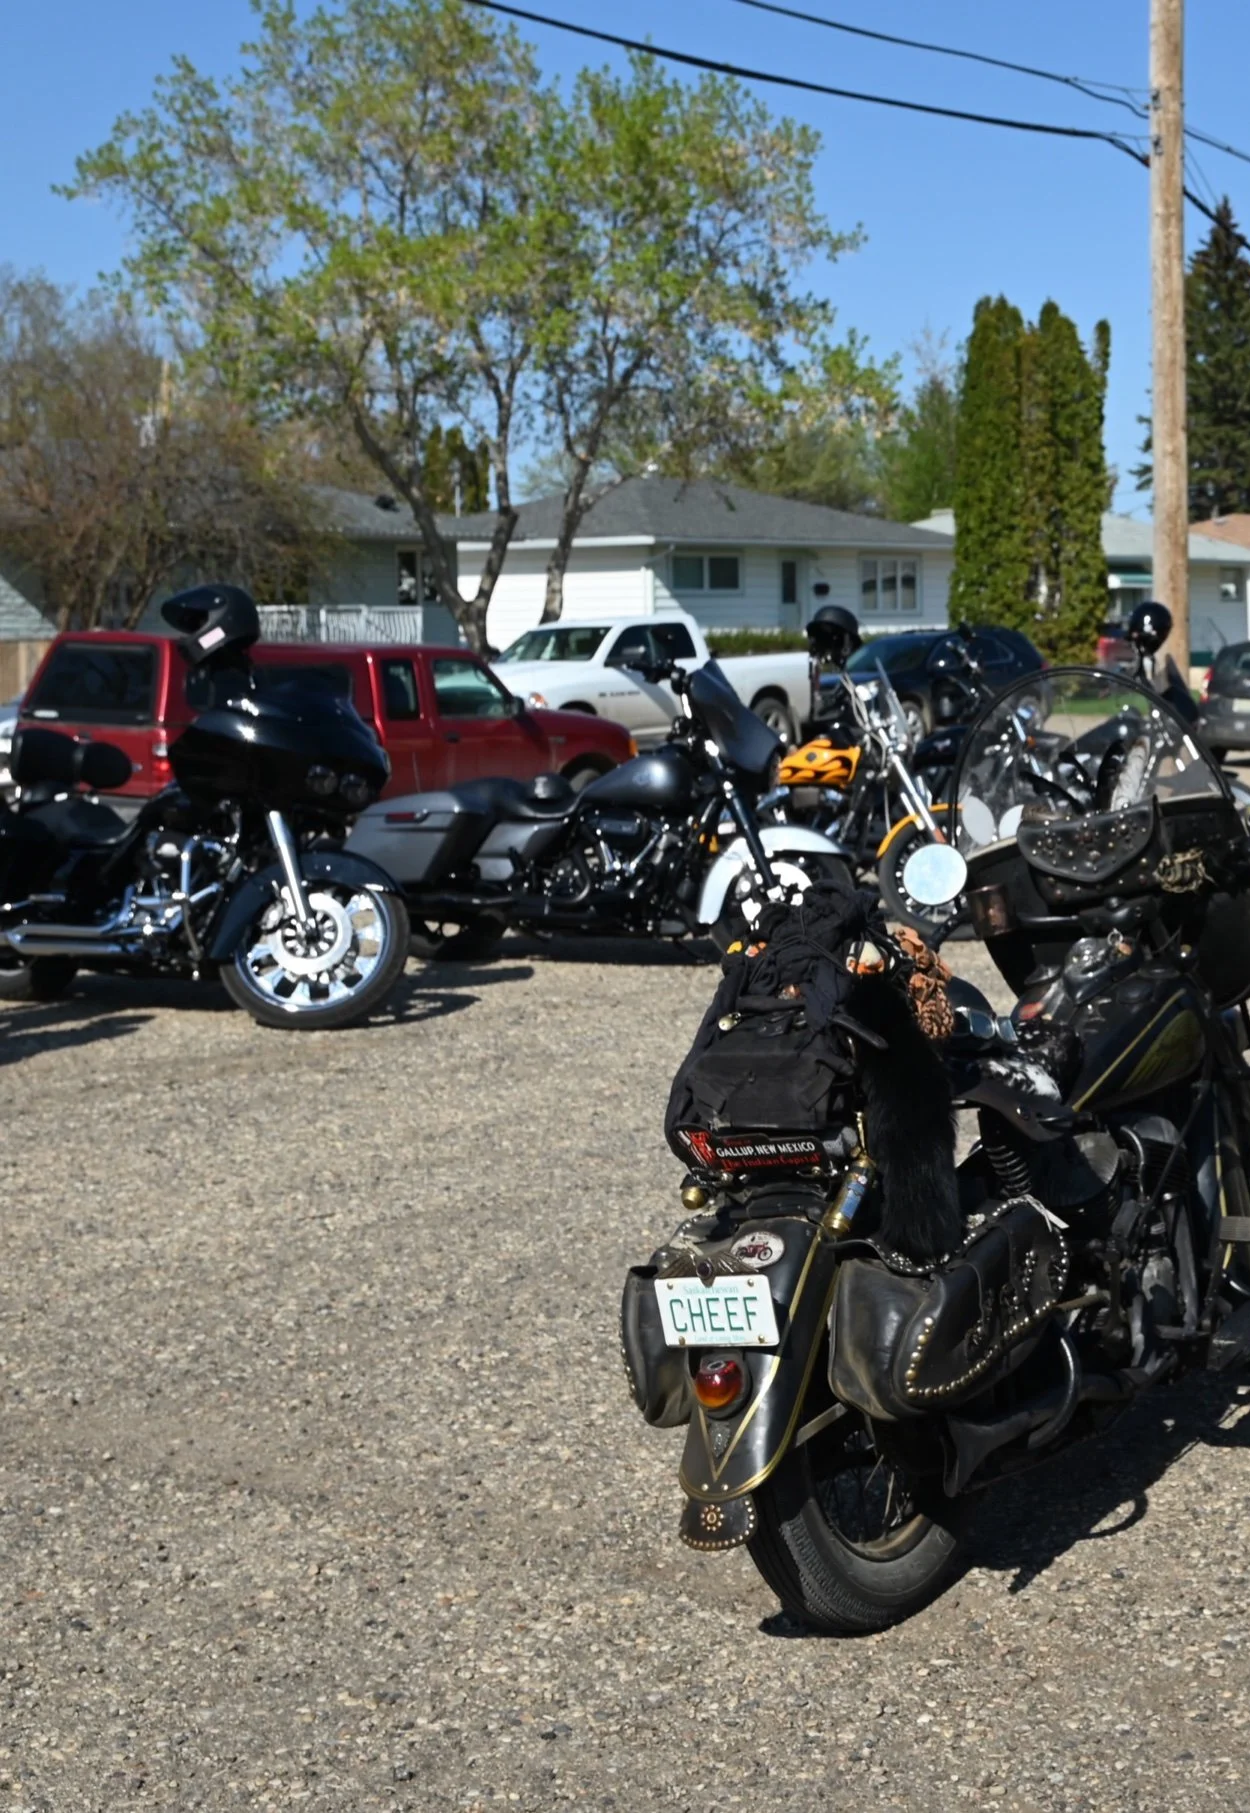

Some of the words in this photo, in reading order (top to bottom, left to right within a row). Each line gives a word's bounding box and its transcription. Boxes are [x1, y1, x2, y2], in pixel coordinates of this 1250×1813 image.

[757, 1143, 777, 1154] NEW
[778, 1141, 815, 1153] MEXICO
[743, 1156, 779, 1168] Indian
[669, 1296, 758, 1333] CHEEF
